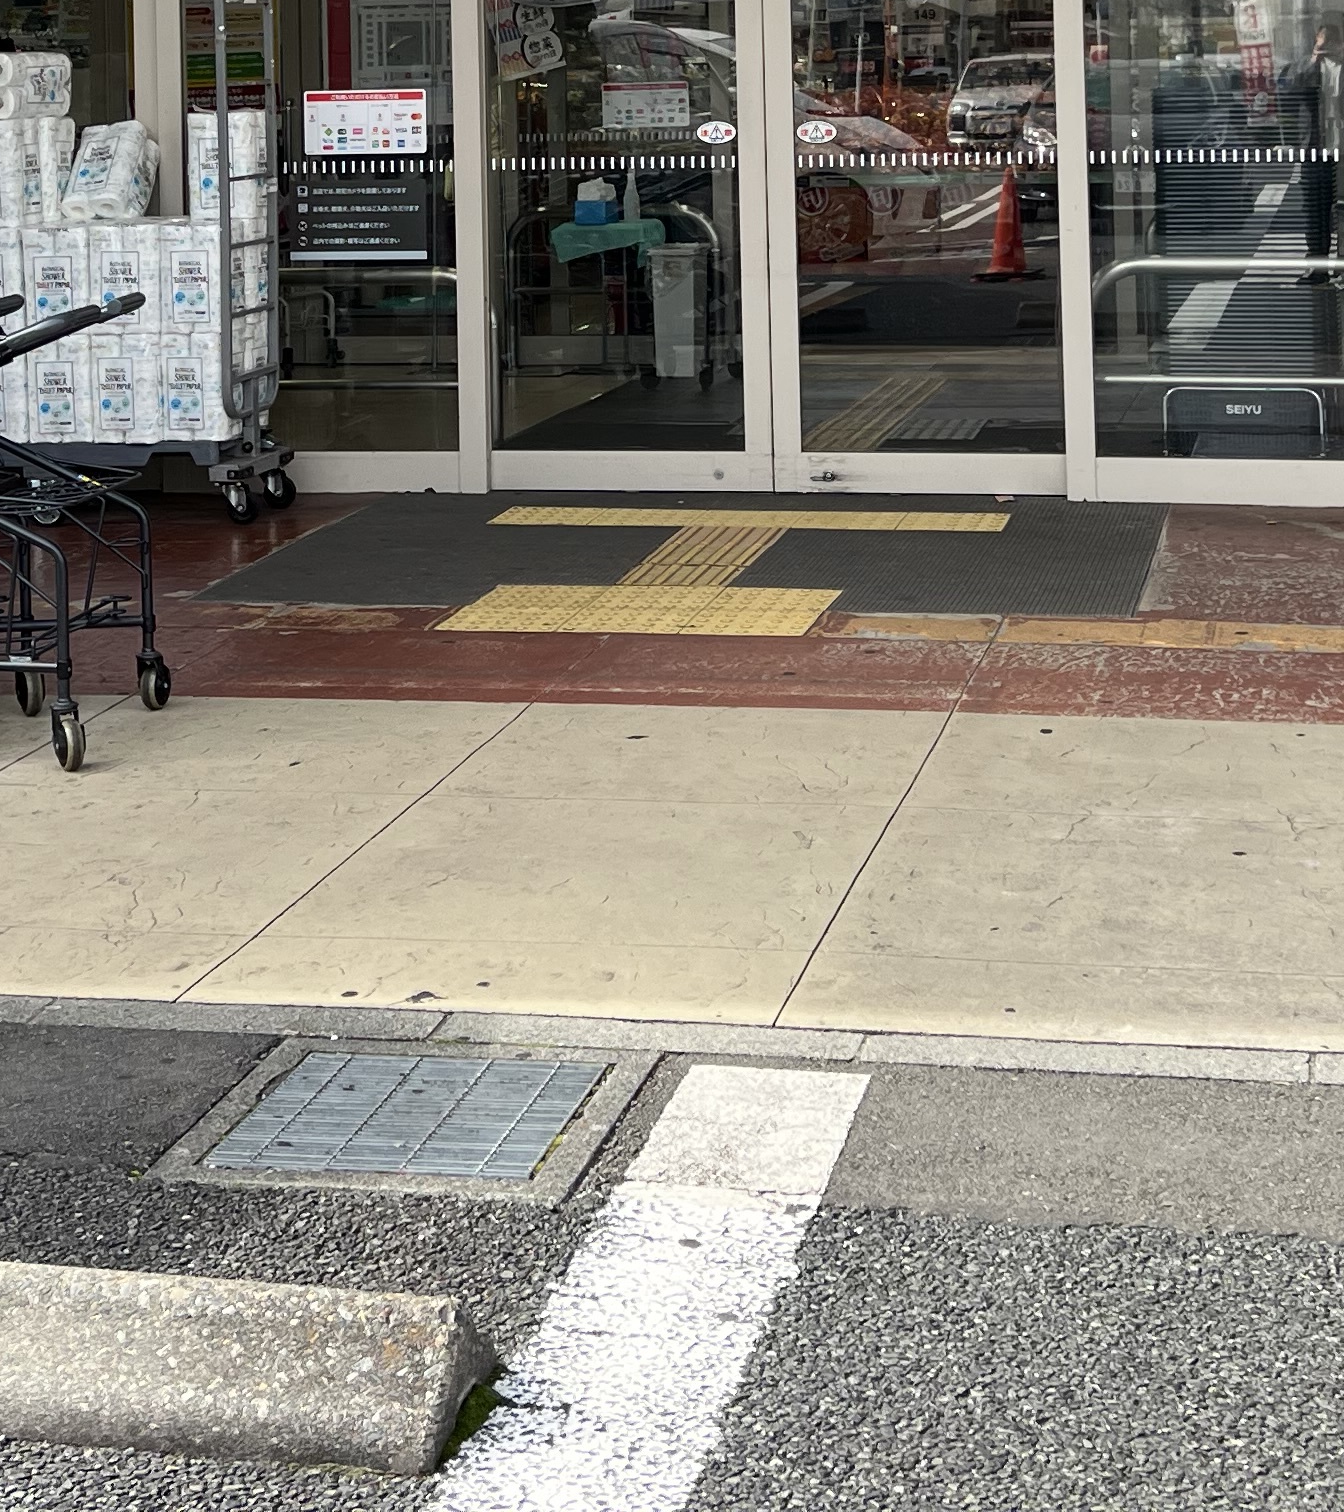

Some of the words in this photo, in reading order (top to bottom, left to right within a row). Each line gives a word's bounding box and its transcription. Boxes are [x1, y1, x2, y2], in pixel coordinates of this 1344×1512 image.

[109, 267, 132, 276] SHOWER
[178, 267, 202, 276] SHOWER
[41, 272, 66, 281] SHOWER
[43, 377, 67, 386] SHOWER
[105, 373, 126, 382] SHOWER
[175, 373, 196, 382] SHOWER
[1225, 404, 1262, 415] SEIYU
